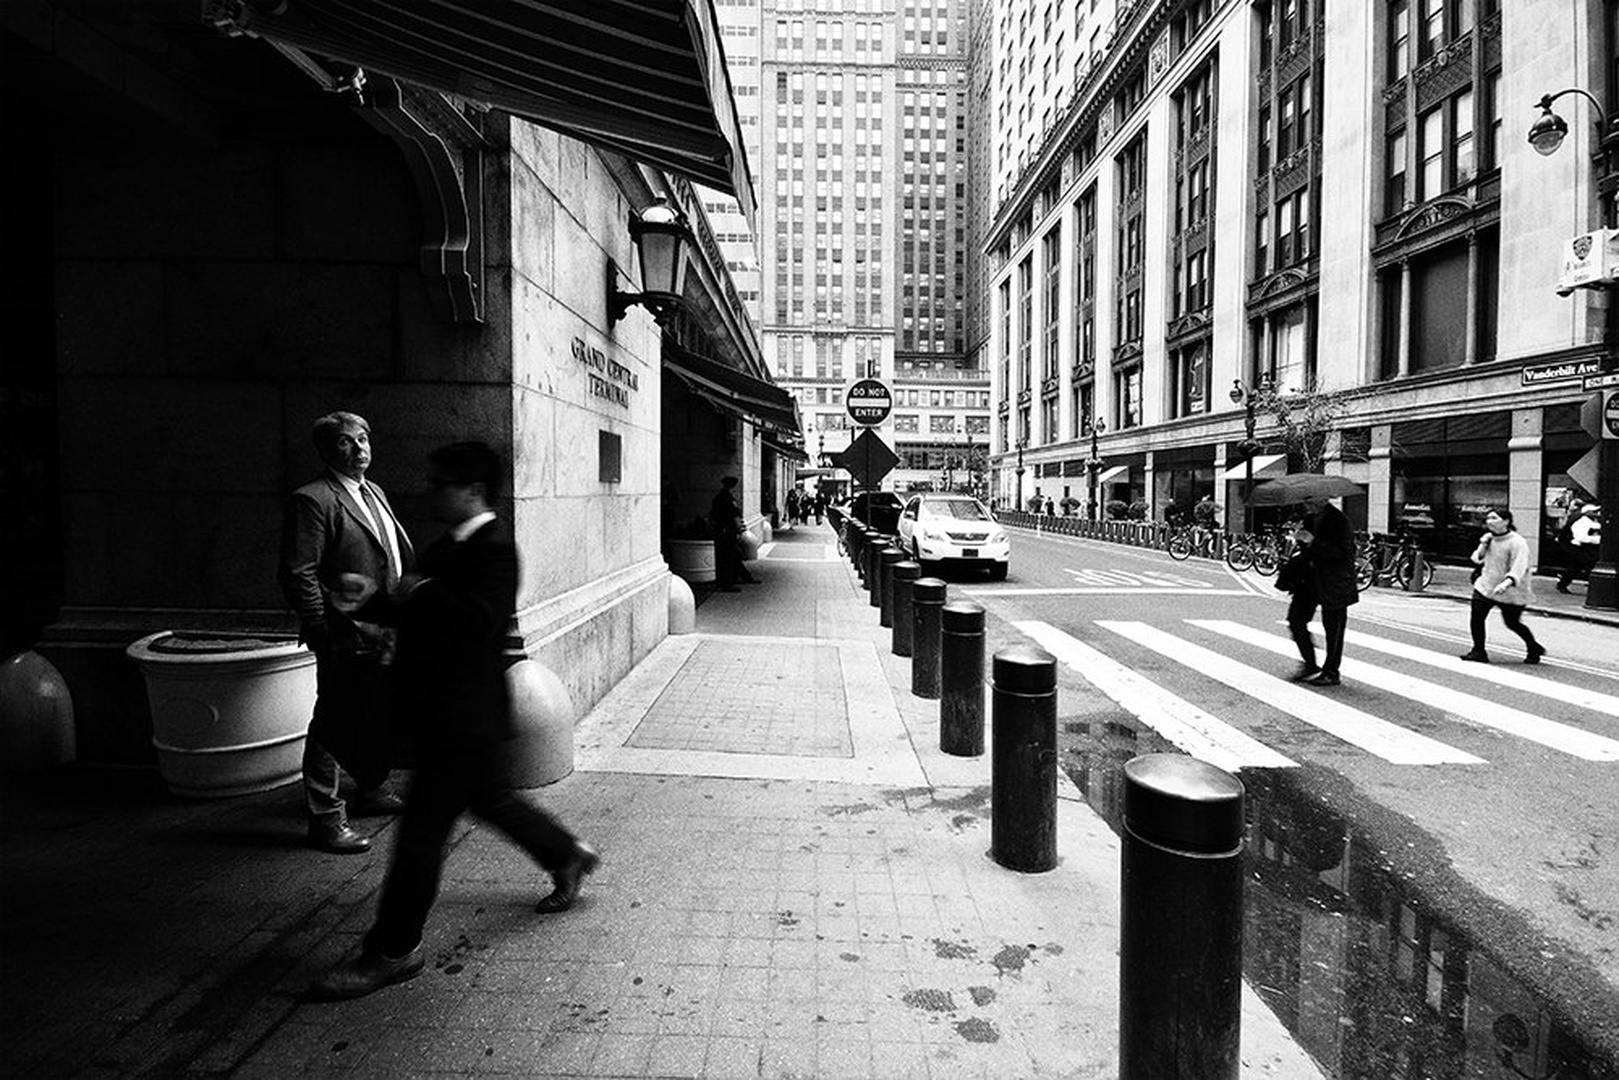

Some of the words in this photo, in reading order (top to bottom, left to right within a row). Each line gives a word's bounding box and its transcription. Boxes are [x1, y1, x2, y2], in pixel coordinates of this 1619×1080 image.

[571, 335, 606, 373] GRAND
[607, 358, 638, 392] CENTRAL
[1525, 364, 1576, 380] Vanderbilt
[1577, 363, 1599, 375] Ave
[588, 372, 629, 409] TERMINAL
[852, 387, 865, 397] DO
[868, 387, 885, 397] NOT
[855, 408, 883, 417] ENTER
